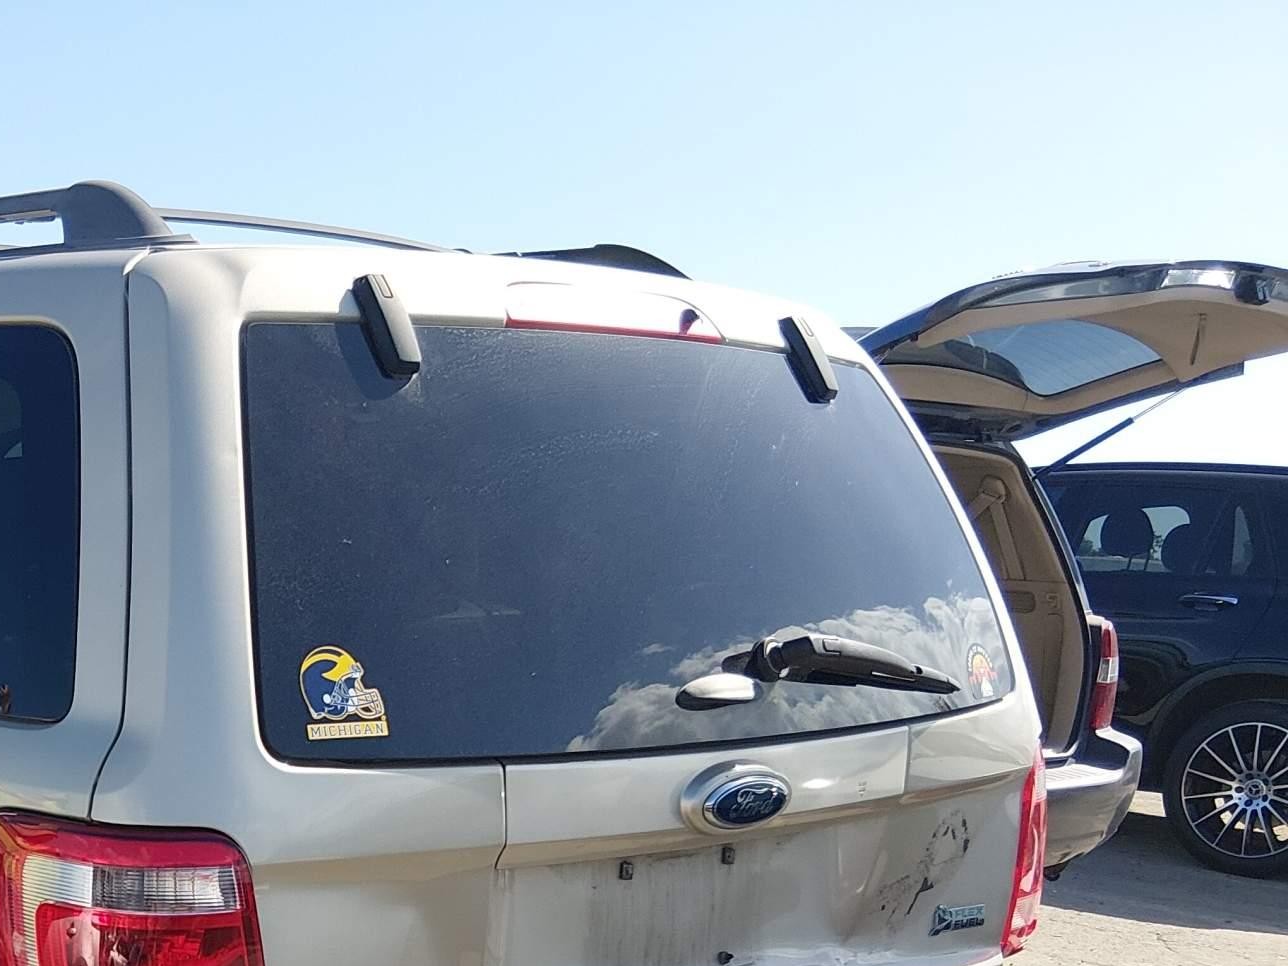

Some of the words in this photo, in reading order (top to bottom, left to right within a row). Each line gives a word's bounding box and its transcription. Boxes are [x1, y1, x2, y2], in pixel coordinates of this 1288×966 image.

[310, 723, 385, 738] MICHIGAN
[730, 787, 779, 818] Ford
[951, 904, 985, 919] FLEX
[951, 917, 985, 930] FUEL
